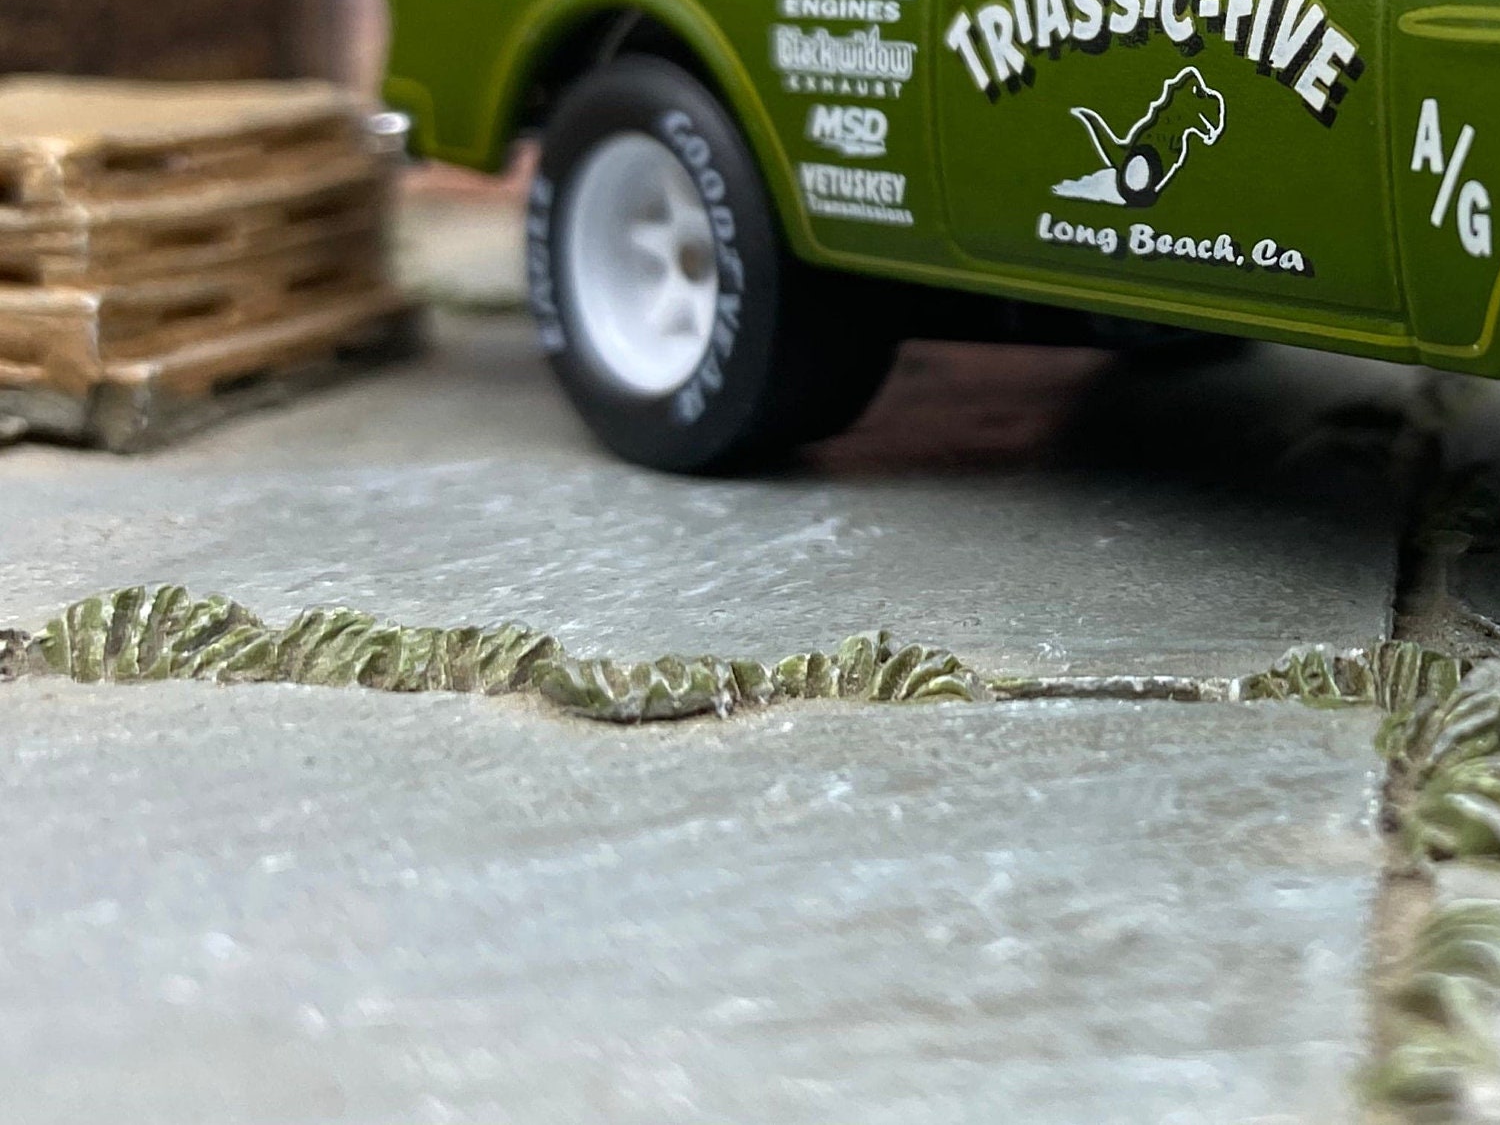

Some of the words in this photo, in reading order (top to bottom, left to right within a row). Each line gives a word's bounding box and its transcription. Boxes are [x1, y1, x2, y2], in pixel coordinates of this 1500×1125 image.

[809, 103, 889, 142] MSD
[1410, 98, 1492, 258] A/G
[1038, 212, 1118, 254] Long
[1128, 223, 1245, 266] Beach,
[1251, 238, 1305, 272] Ca
